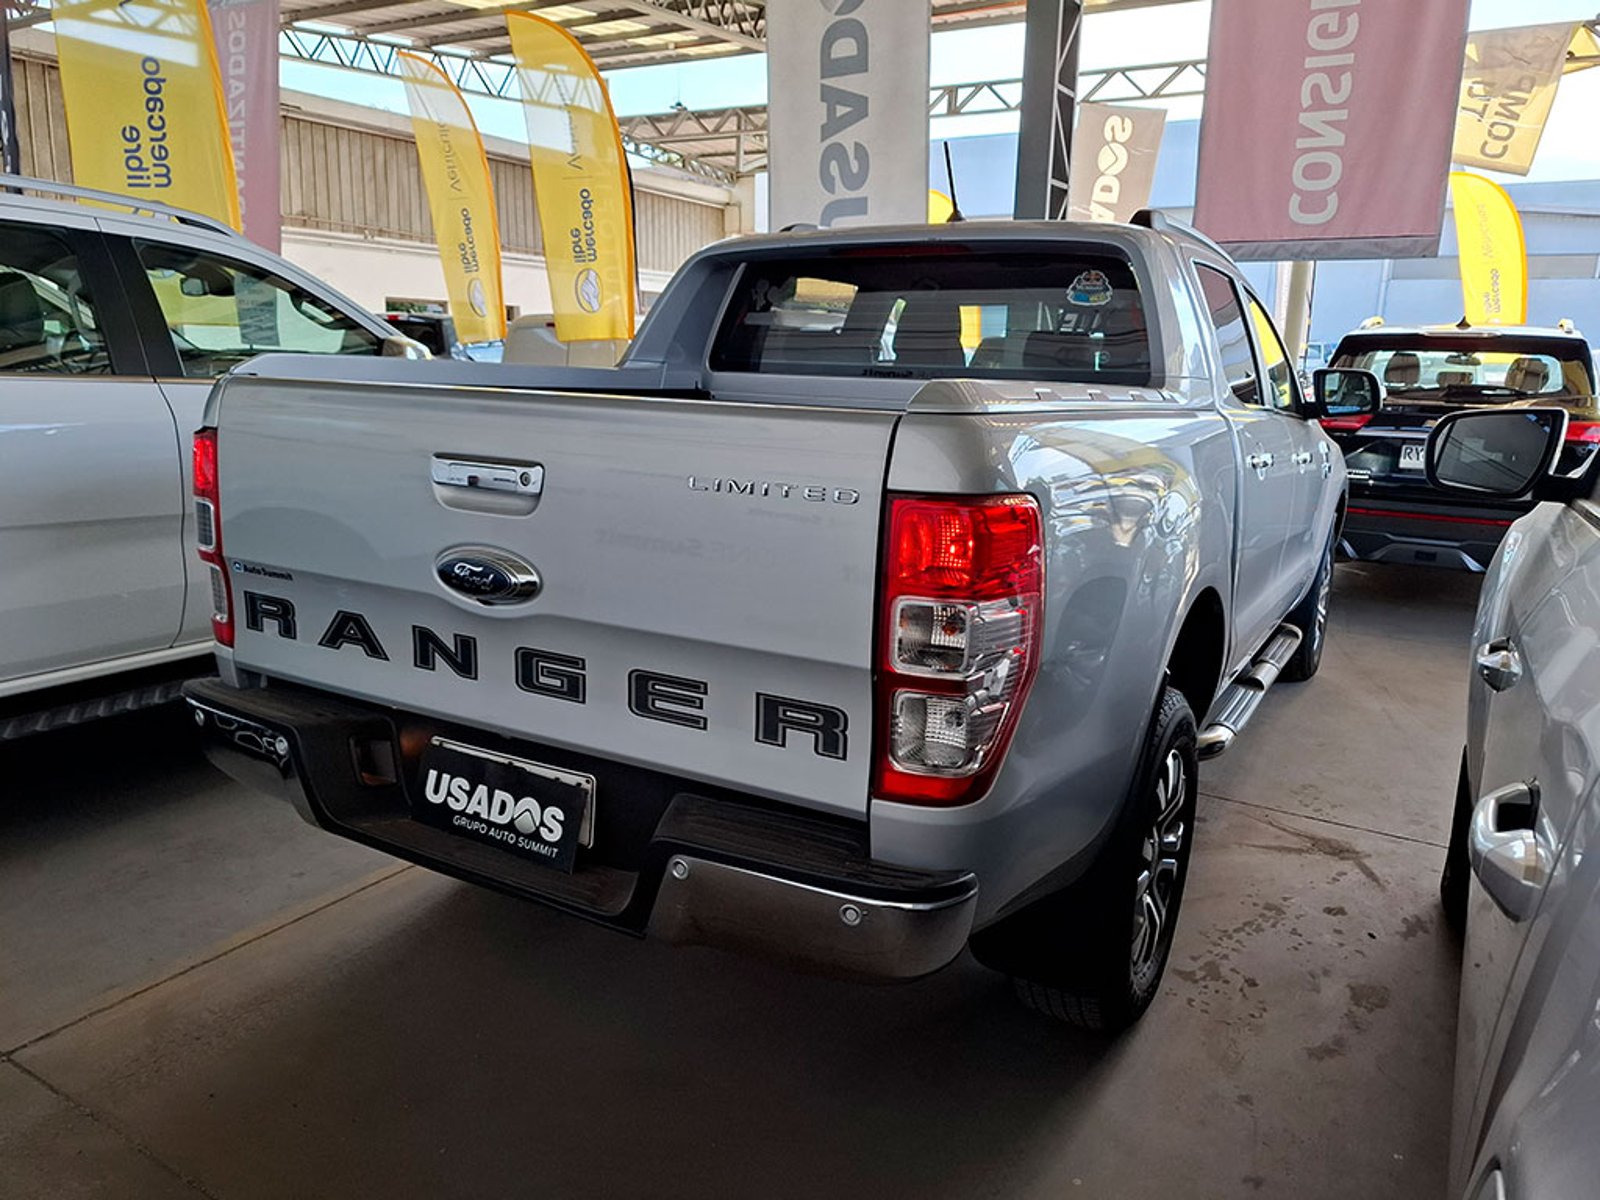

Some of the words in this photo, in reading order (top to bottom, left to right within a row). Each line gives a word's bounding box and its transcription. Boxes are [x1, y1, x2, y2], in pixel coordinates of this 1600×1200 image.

[687, 475, 860, 505] LIMITED
[454, 562, 494, 585] Ford
[243, 590, 849, 761] RANGER
[425, 769, 565, 842] USADOS
[453, 815, 487, 834] GRUPO
[488, 826, 516, 845] AUTO
[517, 837, 559, 859] SUMMIT
